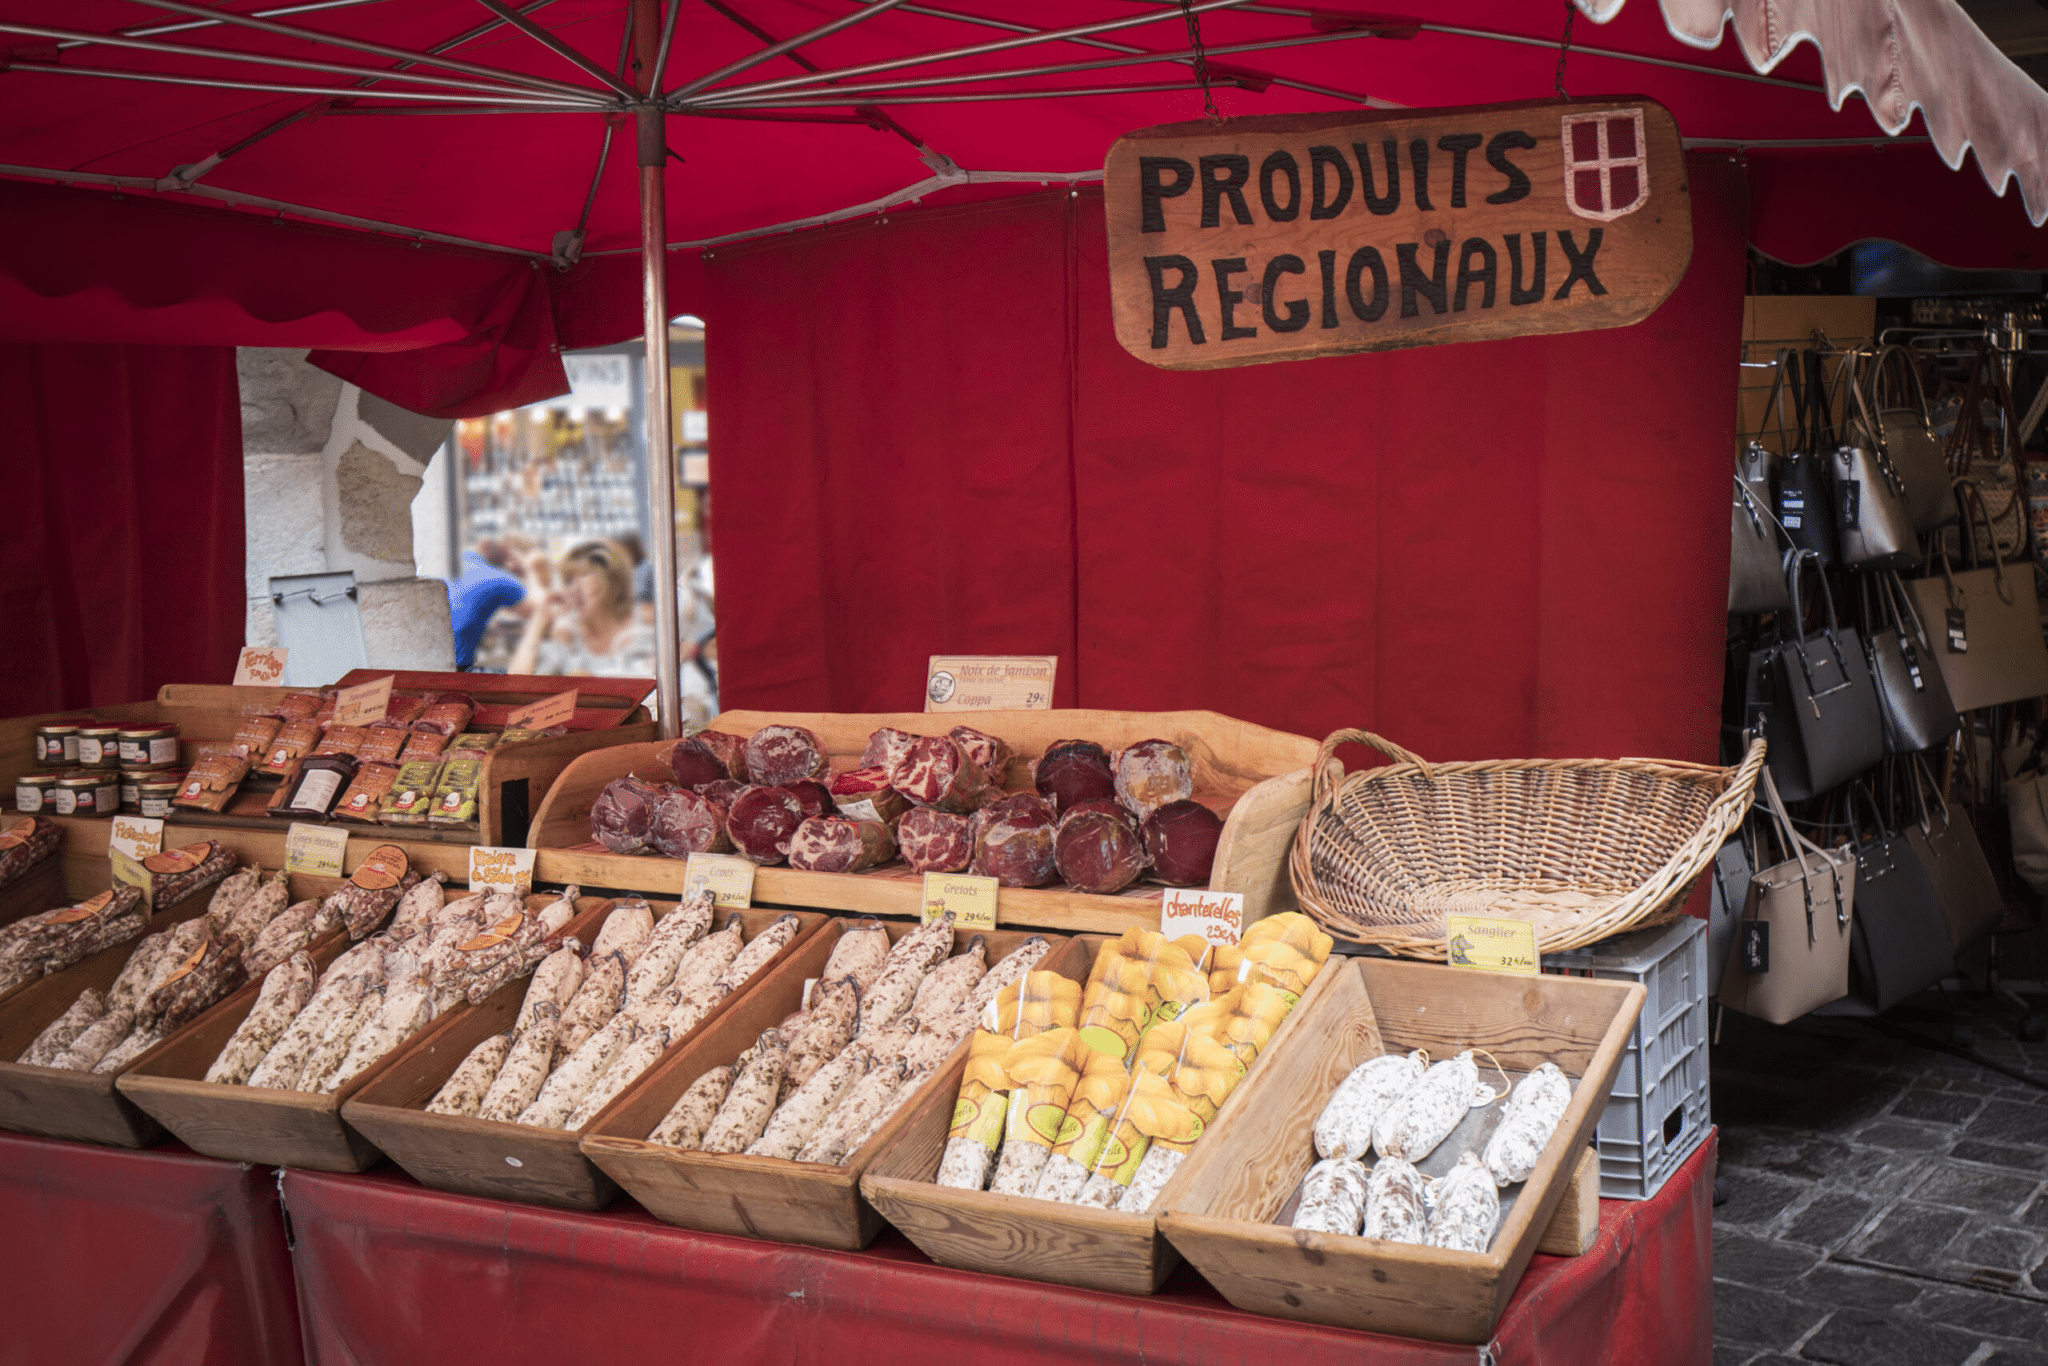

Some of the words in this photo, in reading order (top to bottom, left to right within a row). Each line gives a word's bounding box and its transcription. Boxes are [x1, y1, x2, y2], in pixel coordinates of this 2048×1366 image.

[1140, 130, 1538, 234] PRODUITS
[1143, 227, 1609, 350] REGIONAUX
[956, 693, 992, 706] Coppa
[959, 664, 985, 677] Noix
[986, 664, 1001, 677] de
[1002, 664, 1048, 678] Jambon
